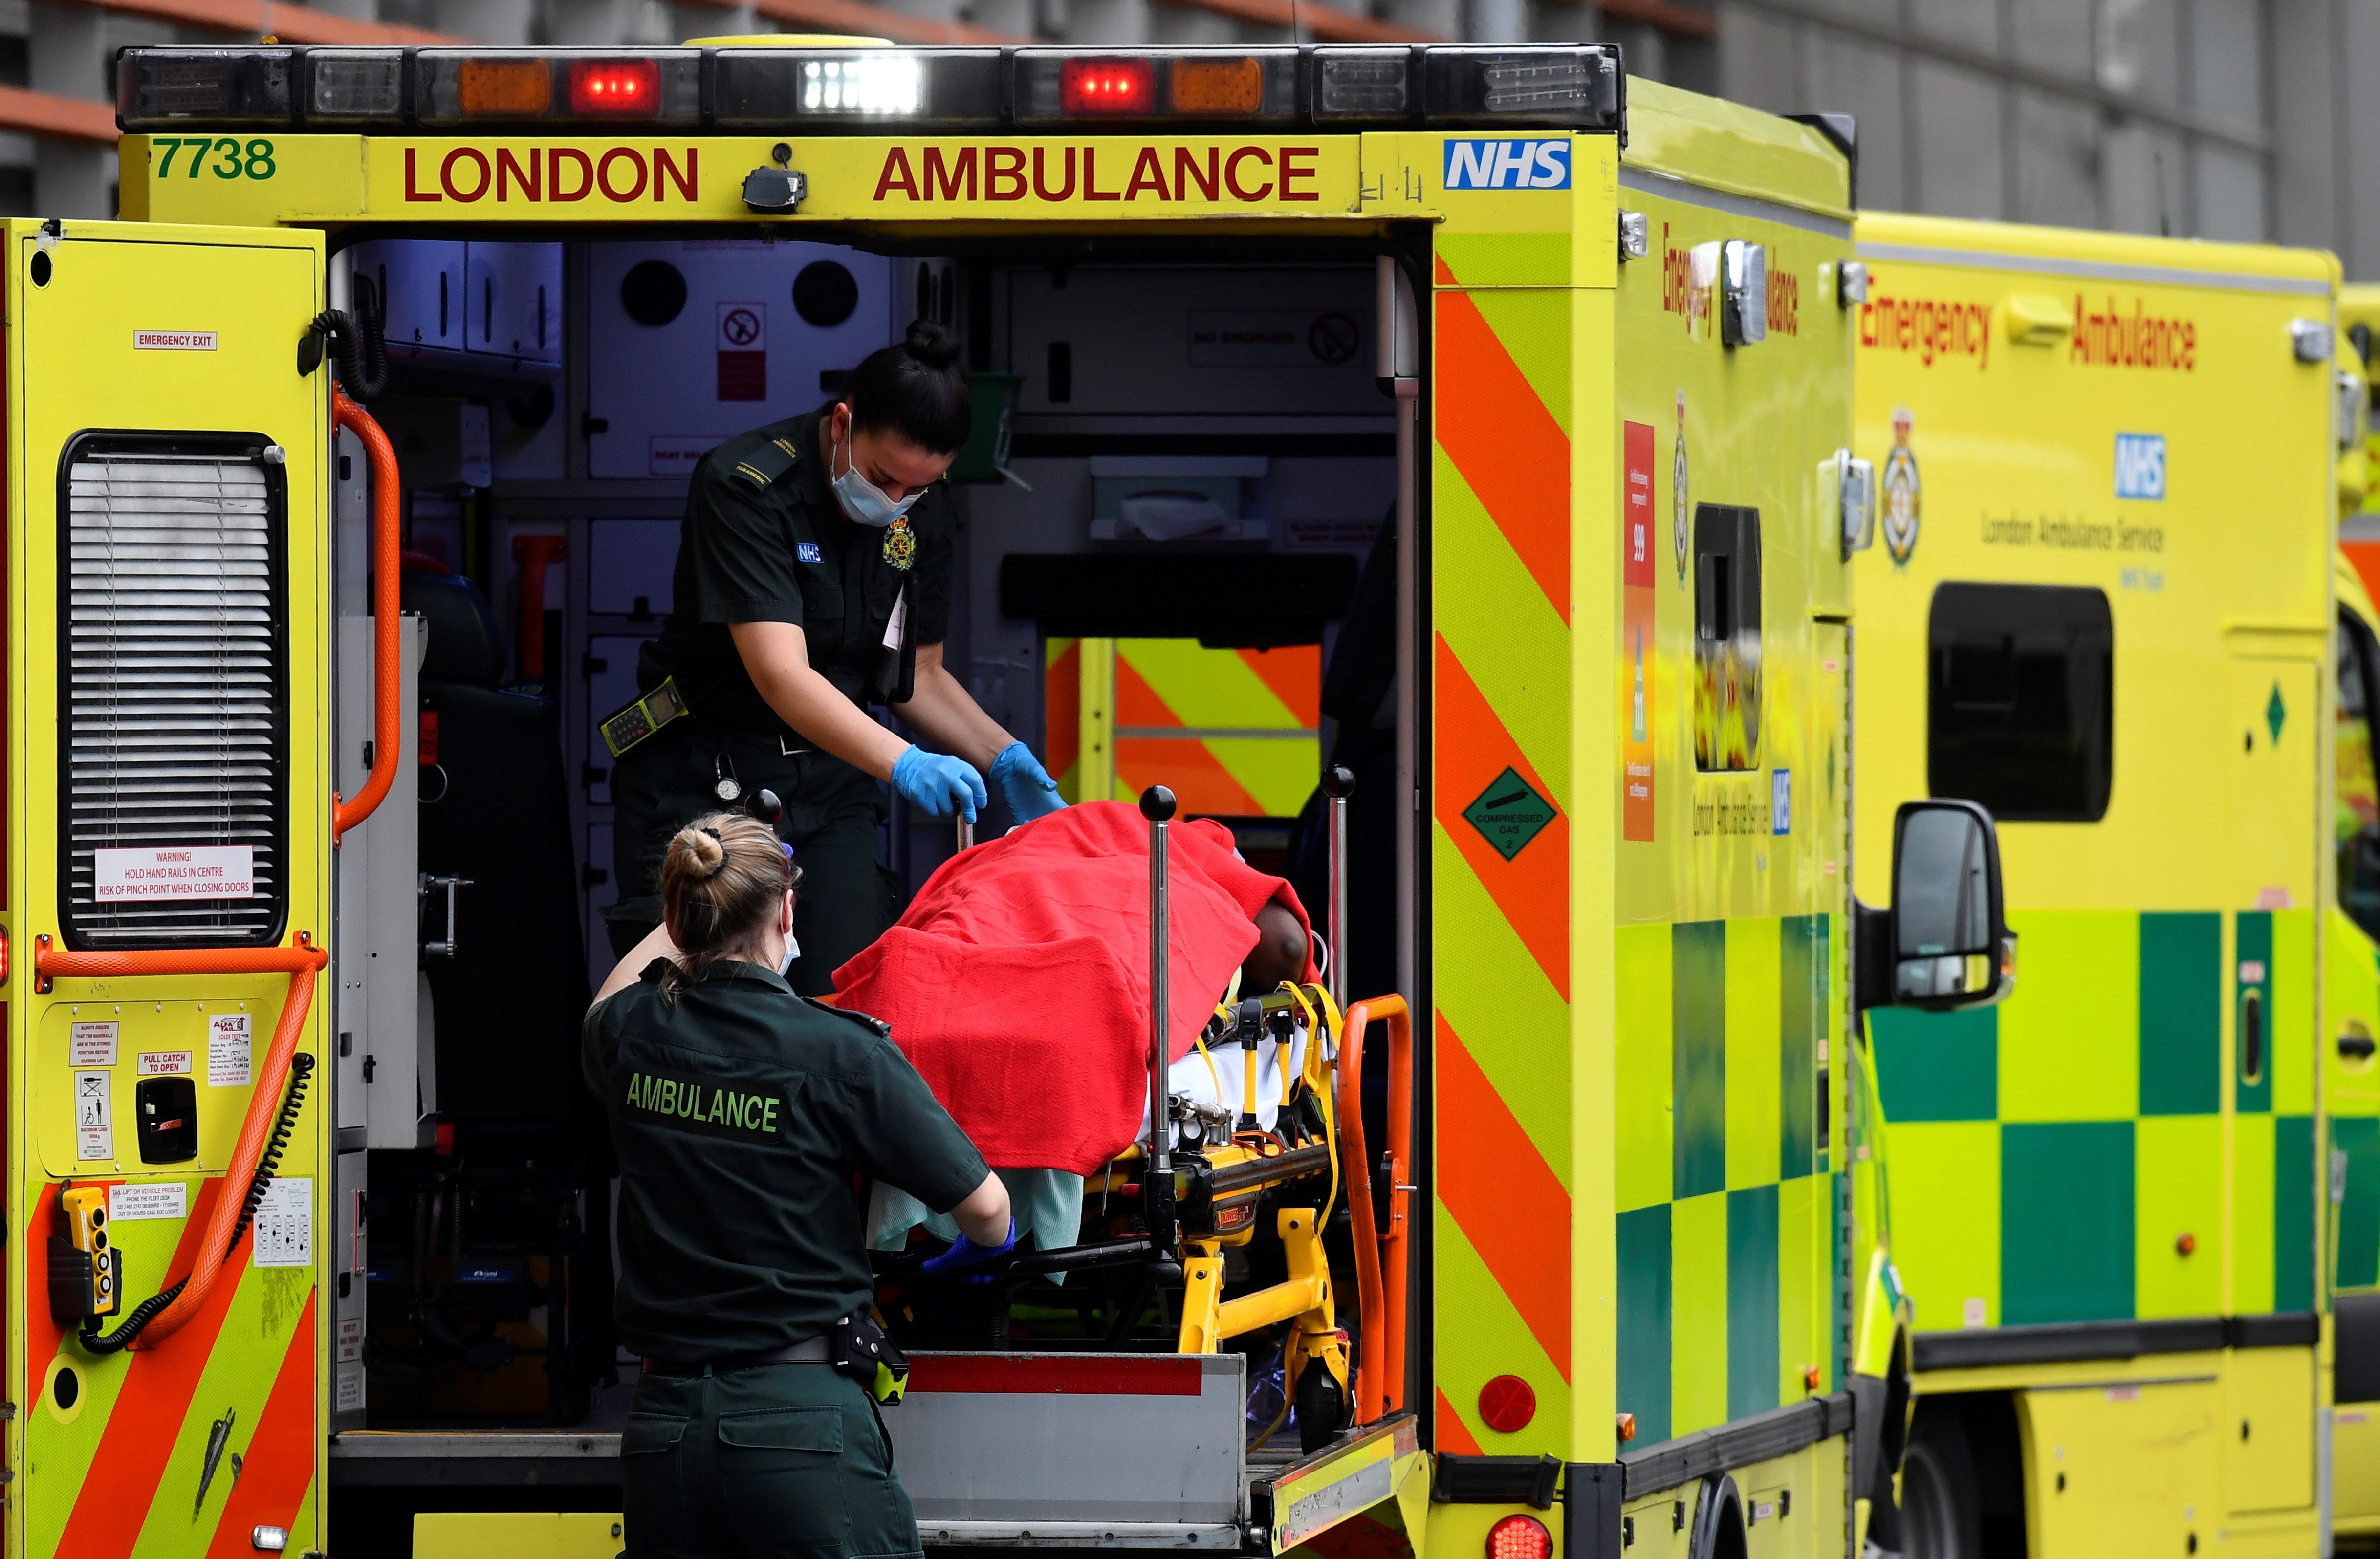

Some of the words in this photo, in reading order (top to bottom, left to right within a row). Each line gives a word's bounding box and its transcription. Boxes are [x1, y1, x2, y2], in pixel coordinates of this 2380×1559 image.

[153, 138, 276, 180] 7738
[1447, 141, 1568, 187] NHS
[404, 147, 698, 202] LONDON
[874, 147, 1320, 201] AMBULANCE
[1765, 246, 1798, 338] ulance
[1861, 276, 1993, 371] Emergency
[2070, 294, 2197, 371] Ambulance
[139, 335, 190, 346] EMERGENCY
[193, 336, 212, 346] EXIT
[780, 438, 796, 453] LONDON
[736, 465, 765, 484] PARAMEDIC
[2116, 439, 2162, 496] NHS
[1981, 510, 2032, 544] London
[2039, 511, 2112, 550] Ambulance
[2117, 516, 2164, 552] Service
[1634, 523, 1645, 562] 999
[799, 545, 821, 561] NHS
[1476, 814, 1543, 823] COMPRESSED
[1506, 841, 1512, 849] 2
[156, 852, 192, 862] WARNING!
[125, 869, 144, 879] HOLD
[146, 868, 166, 878] HAND
[168, 868, 187, 877] RAILS
[189, 867, 196, 877] IN
[197, 867, 223, 877] CENTRE
[99, 886, 114, 895] RISK
[116, 885, 125, 894] OF
[127, 885, 147, 894] PINCH
[150, 884, 170, 894] POINT
[171, 884, 192, 893] WHEN
[194, 883, 223, 892] CLOSING
[225, 882, 249, 892] DOORS
[163, 1054, 185, 1062] CATCH
[160, 1063, 179, 1072] OPEN
[626, 1073, 780, 1133] AMBULANCE
